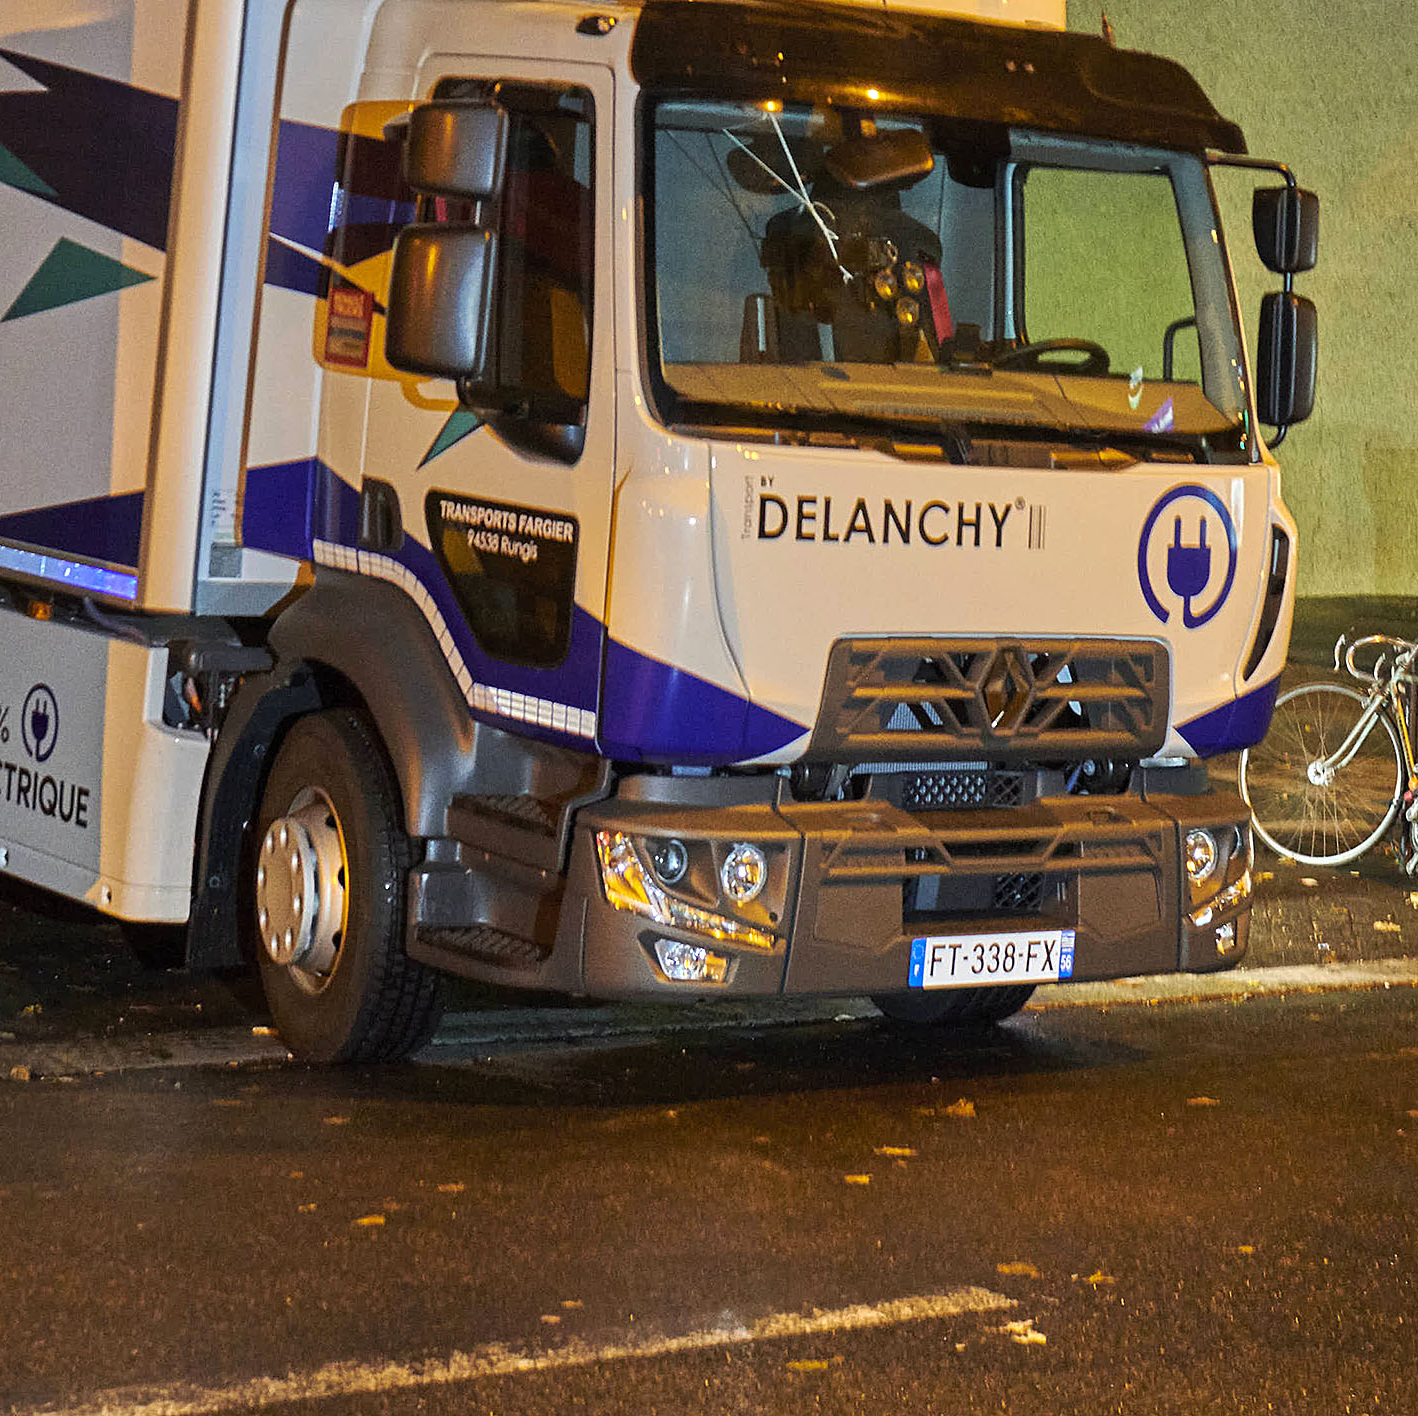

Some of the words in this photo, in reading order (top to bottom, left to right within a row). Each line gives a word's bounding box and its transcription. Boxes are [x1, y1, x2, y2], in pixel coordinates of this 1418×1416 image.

[760, 474, 775, 487] BY
[440, 499, 517, 533] TRANSPORTS
[518, 514, 573, 544] FARGIER
[500, 535, 538, 565] Rungis
[929, 939, 1056, 977] FT-338-FX
[1060, 954, 1072, 970] 56
